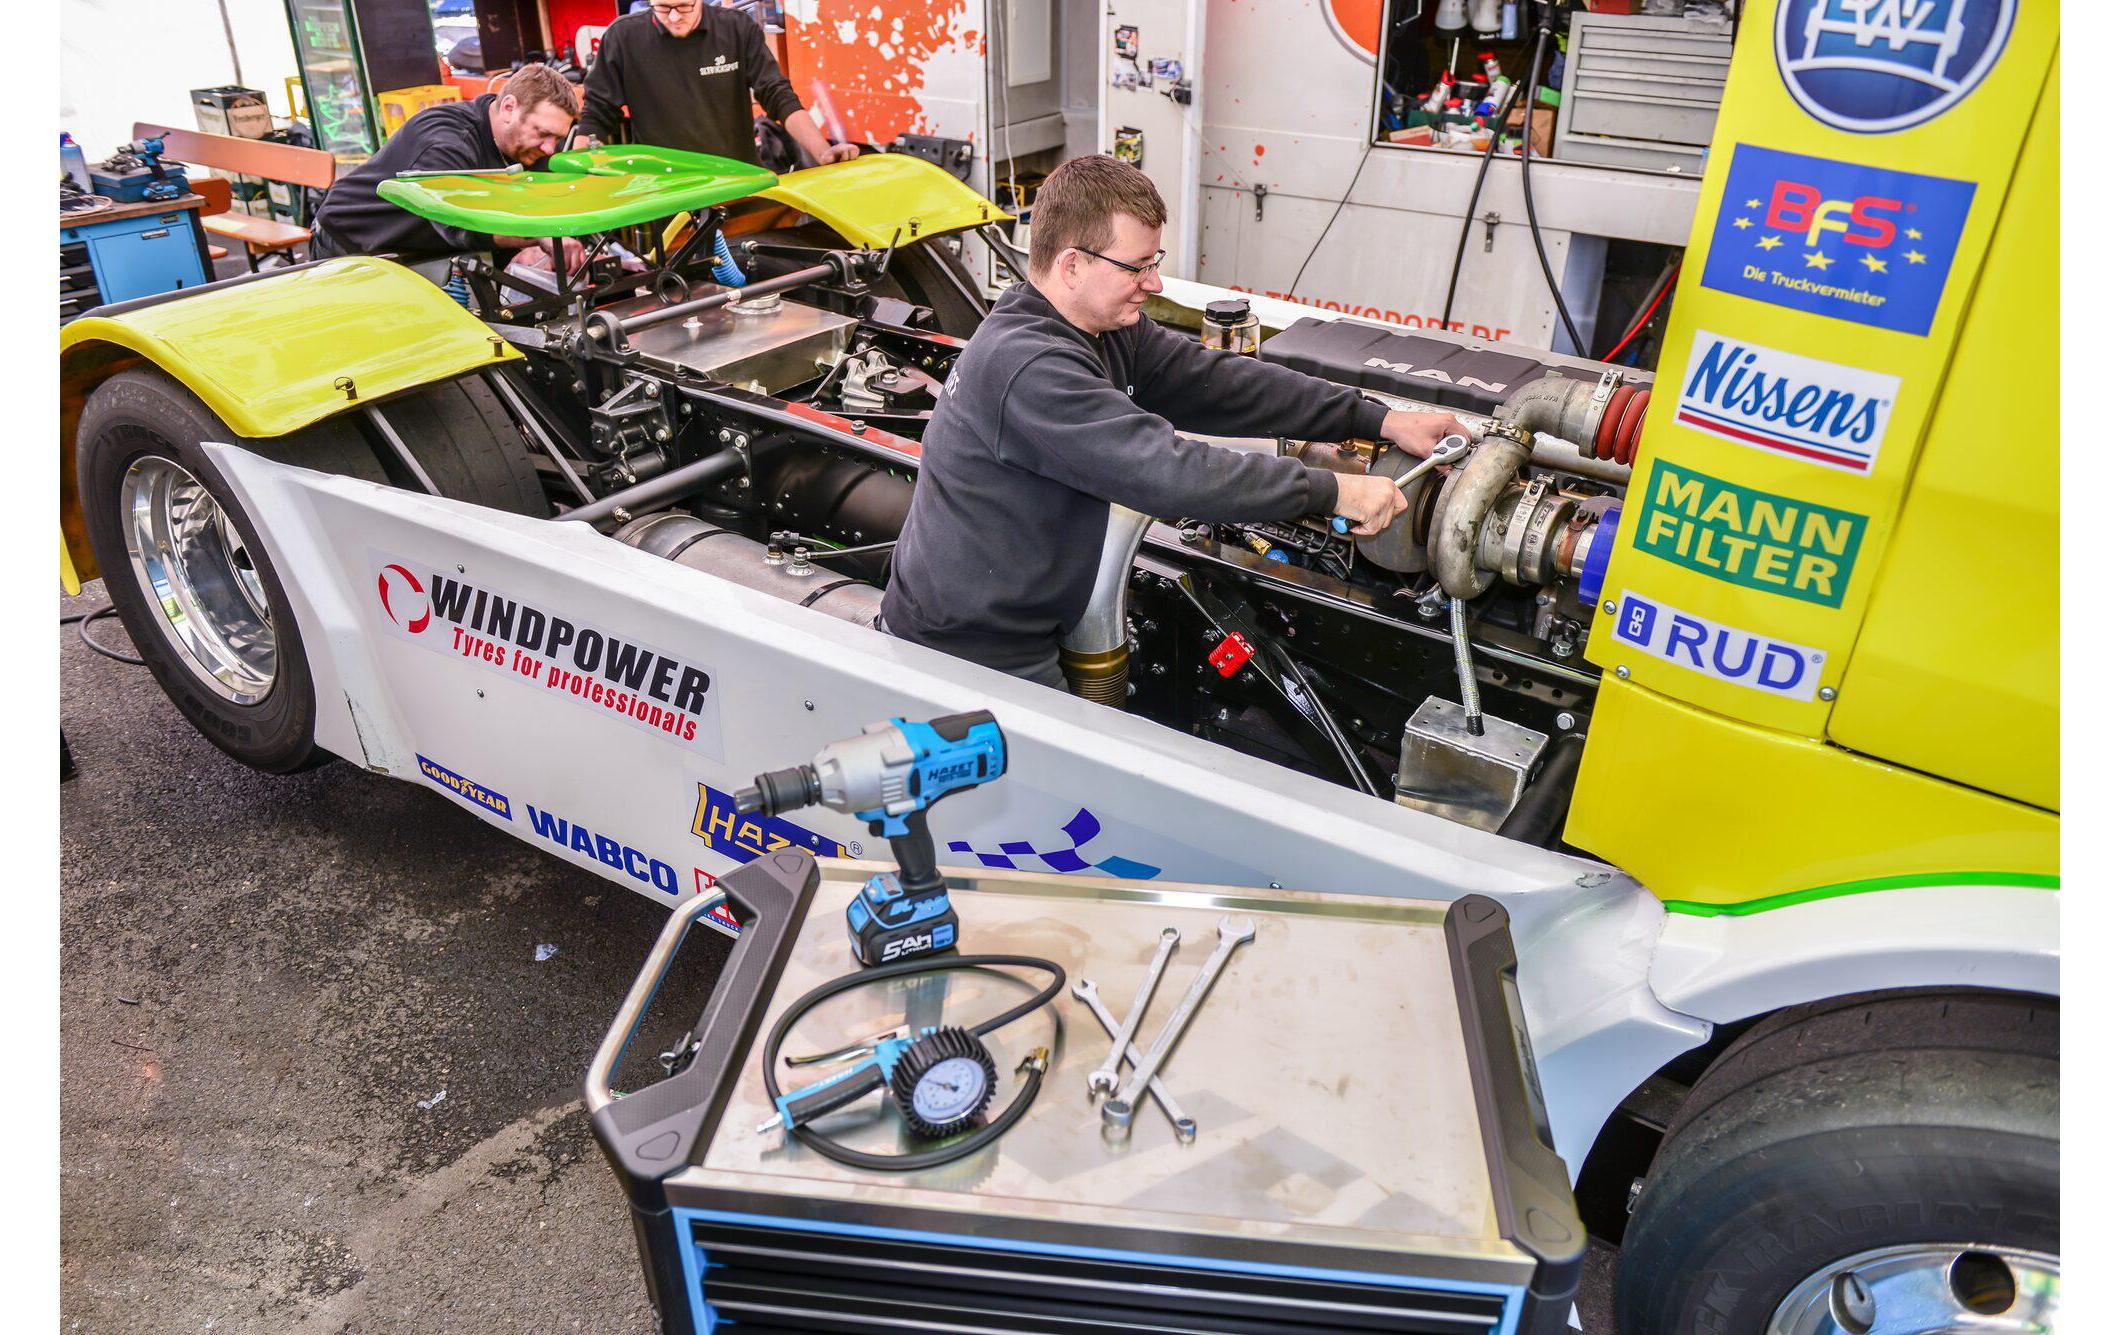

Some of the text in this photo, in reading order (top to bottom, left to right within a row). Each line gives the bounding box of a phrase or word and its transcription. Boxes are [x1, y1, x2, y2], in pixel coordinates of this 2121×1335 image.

[1765, 179, 1902, 250] BfS
[1743, 265, 1886, 307] Die Truckvermieter
[1363, 357, 1508, 395] MAN
[1685, 340, 1879, 444] Nissens
[1645, 511, 1840, 598] FILTER
[1655, 470, 1852, 557] MANN
[431, 574, 711, 716] WINDPOWER
[452, 626, 698, 743] Tyres for professionals
[1665, 614, 1806, 691] RUD
[928, 760, 974, 782] HAZET
[526, 804, 679, 896] WABCO
